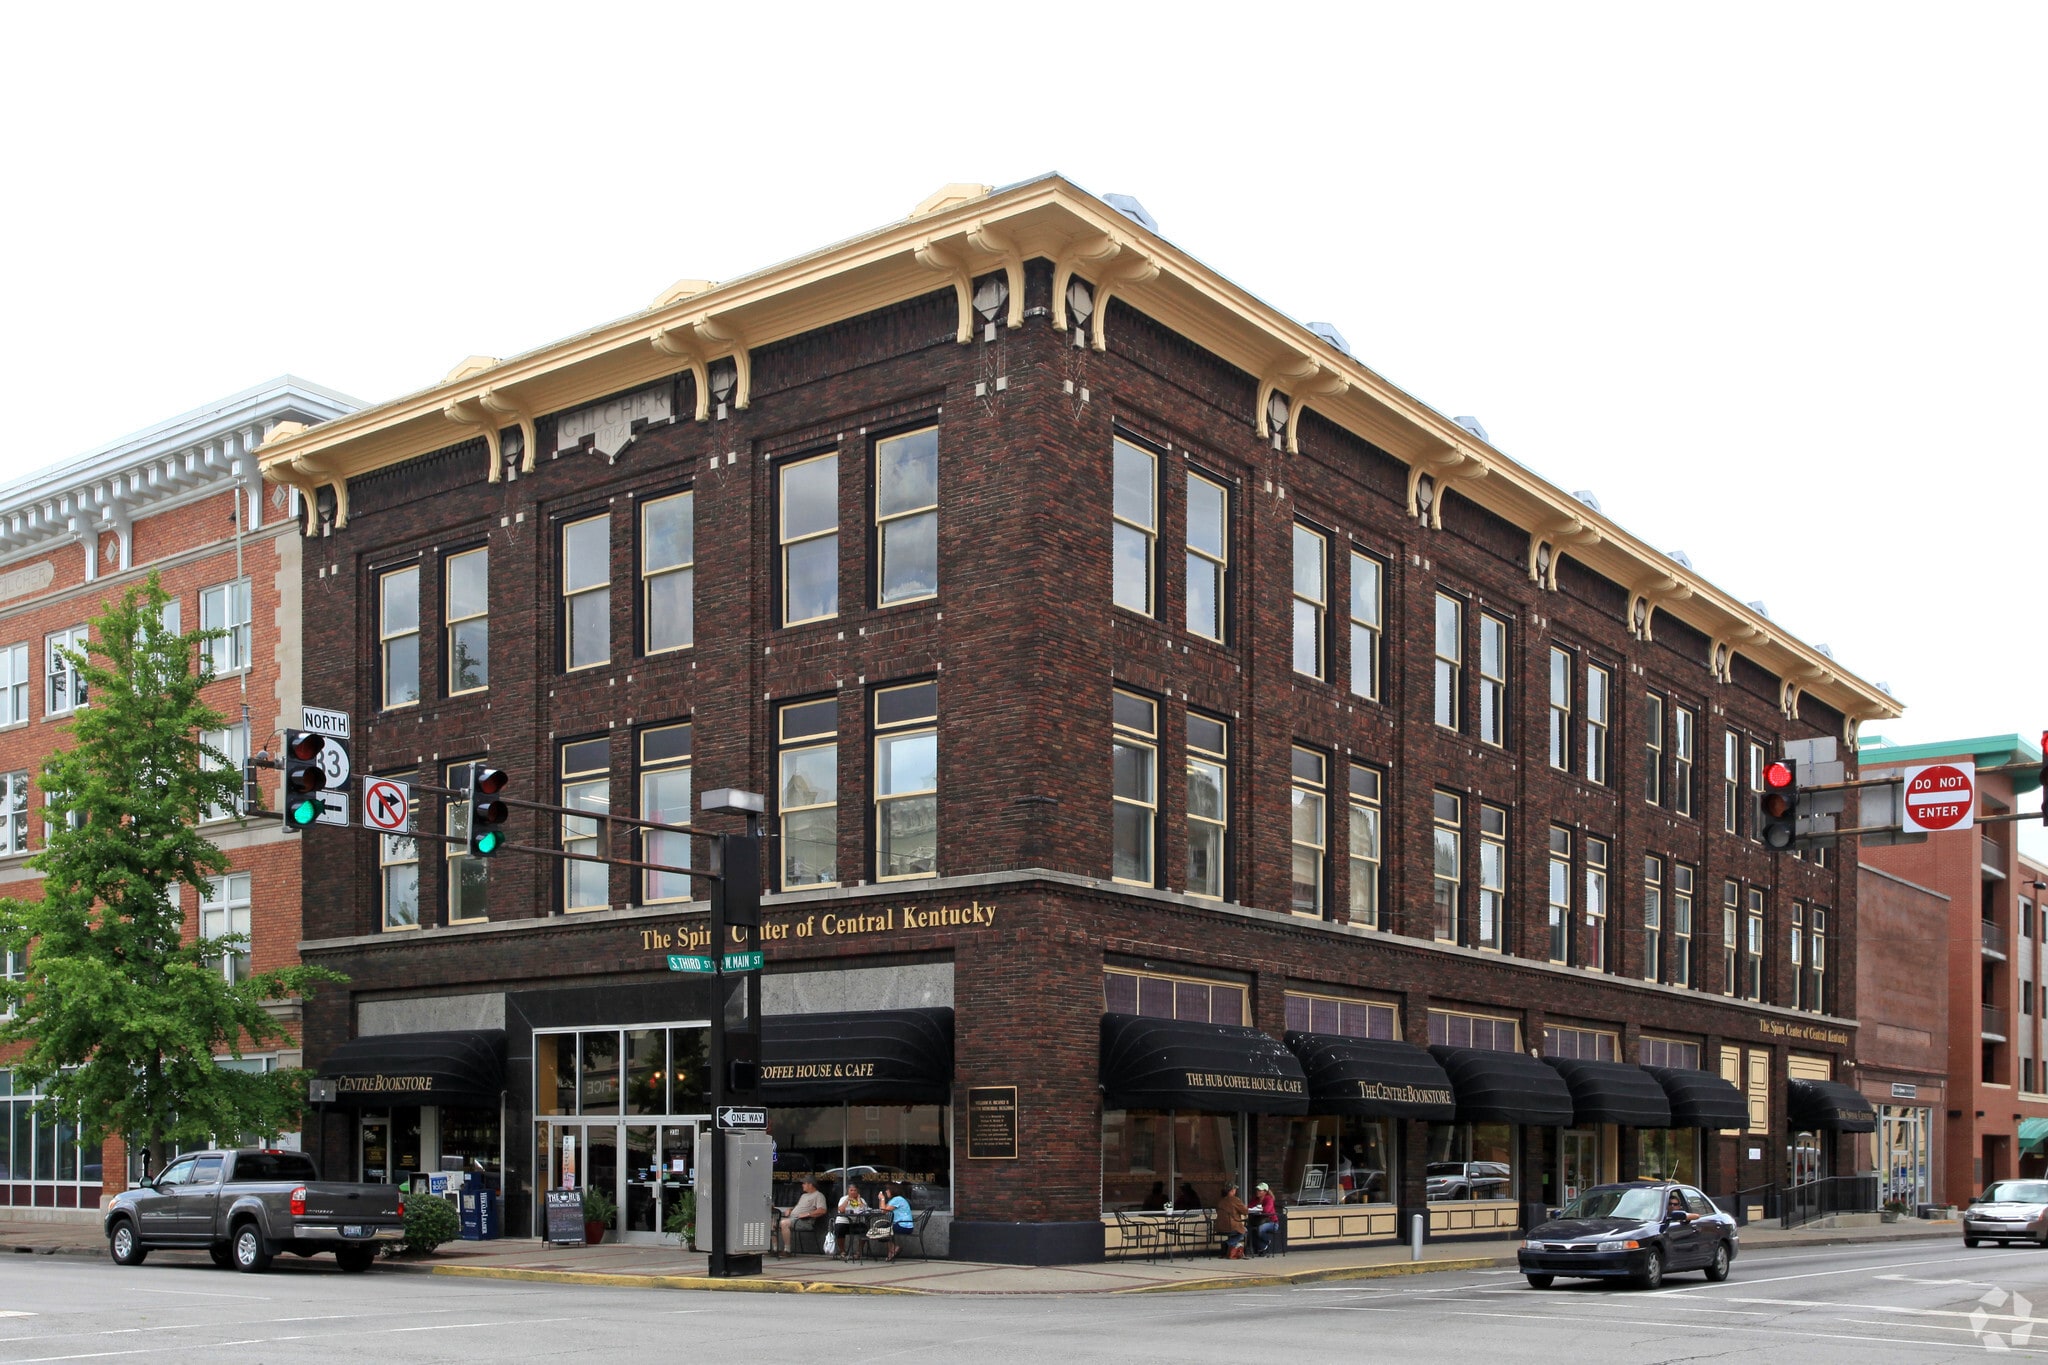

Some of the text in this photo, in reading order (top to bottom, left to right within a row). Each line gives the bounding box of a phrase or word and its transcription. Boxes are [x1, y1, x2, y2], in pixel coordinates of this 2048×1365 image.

[563, 391, 665, 438] GILCHER
[305, 713, 346, 732] NORTH
[1915, 776, 1964, 790] DO NOT
[1918, 806, 1959, 818] ENTER
[640, 930, 671, 950] The
[677, 925, 712, 951] Spin
[796, 916, 815, 937] of
[821, 908, 893, 935] Central
[903, 901, 997, 929] Kentucky
[679, 958, 700, 970] THIRD
[704, 960, 711, 969] ST
[733, 955, 749, 968] MAIN
[753, 955, 761, 965] ST
[1760, 1019, 1848, 1047] The Spine Center of Central Kentucky
[796, 1064, 831, 1078] HOUSE
[834, 1064, 842, 1077] &
[845, 1063, 874, 1077] CAFE
[1186, 1072, 1303, 1093] THE HUB COFFEE HOUSE & CAFE
[731, 1113, 763, 1122] ONE WAY
[547, 1192, 581, 1203] THE HUB
